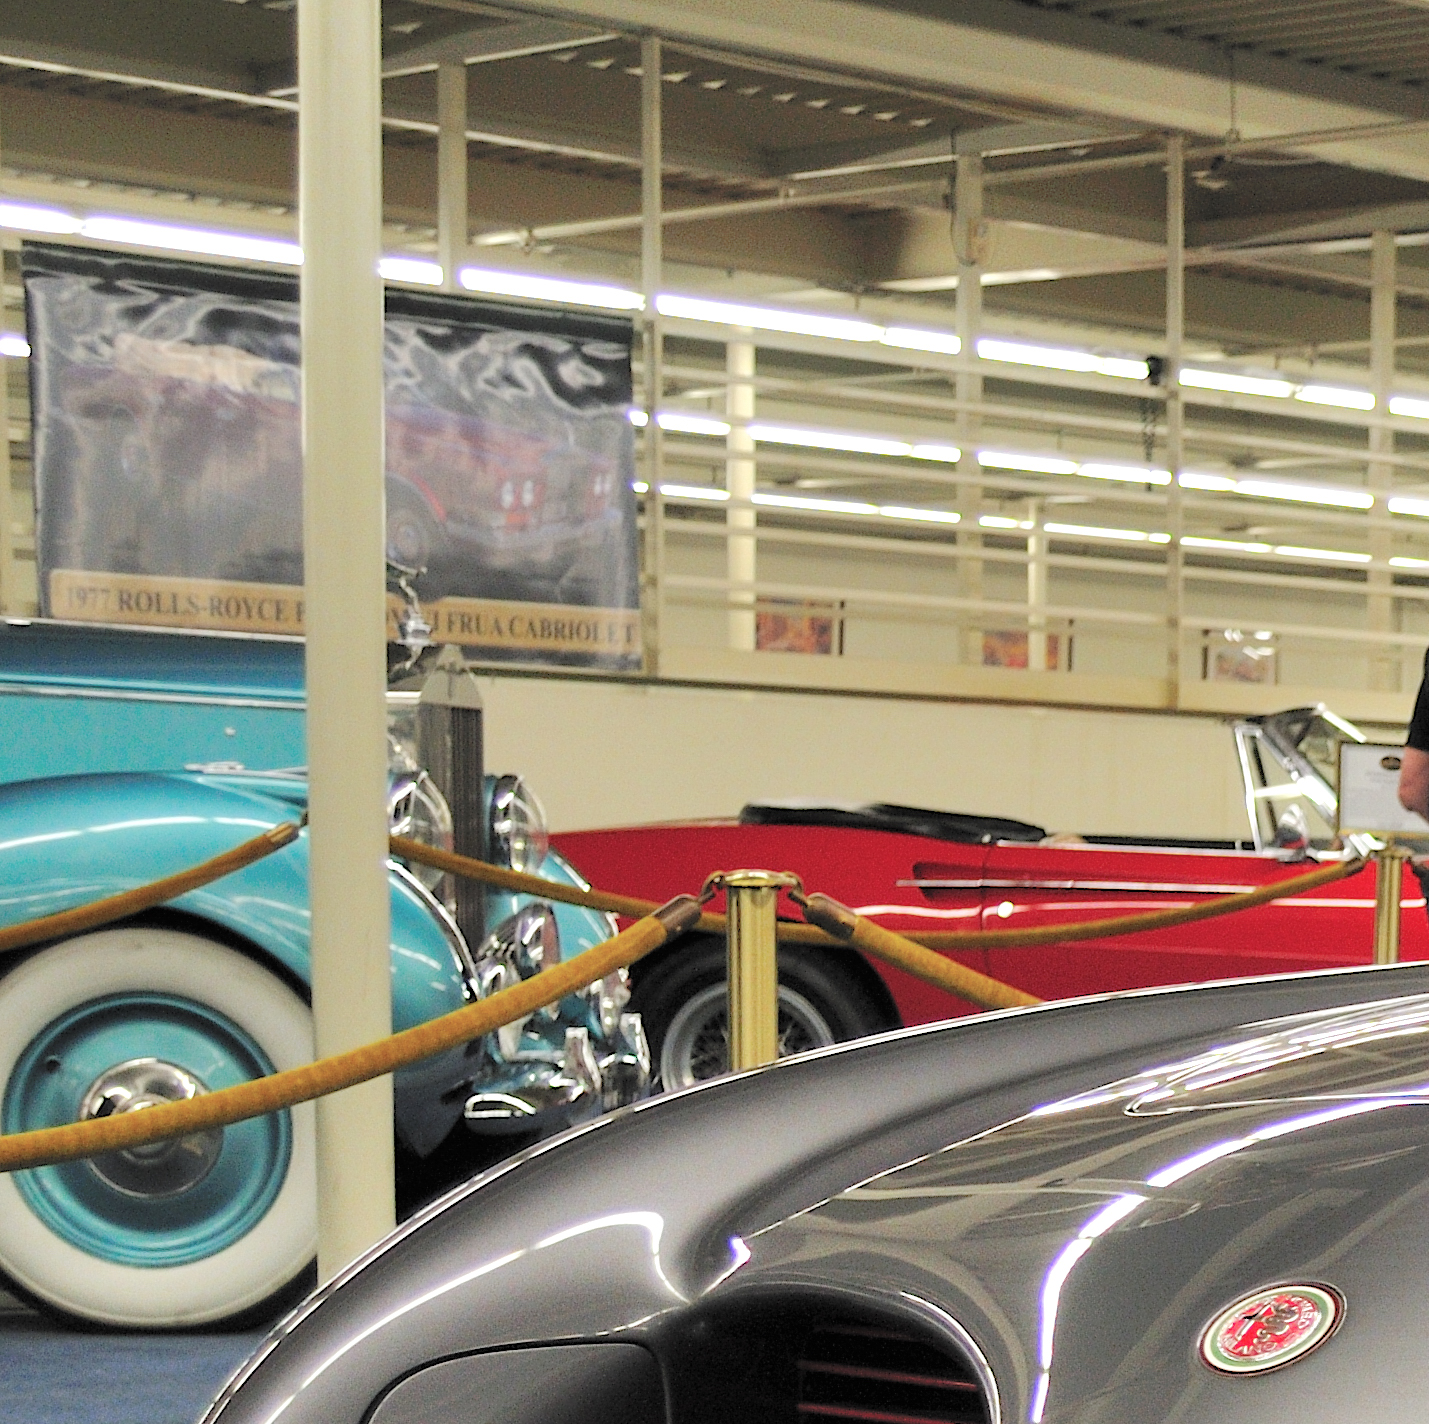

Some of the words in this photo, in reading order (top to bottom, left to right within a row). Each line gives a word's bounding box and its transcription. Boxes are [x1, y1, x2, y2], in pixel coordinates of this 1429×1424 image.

[66, 586, 111, 609] 1977
[118, 590, 285, 622] ROLLS-ROYCE
[447, 612, 502, 636] FRUA
[509, 615, 636, 644] CABRIOLET
